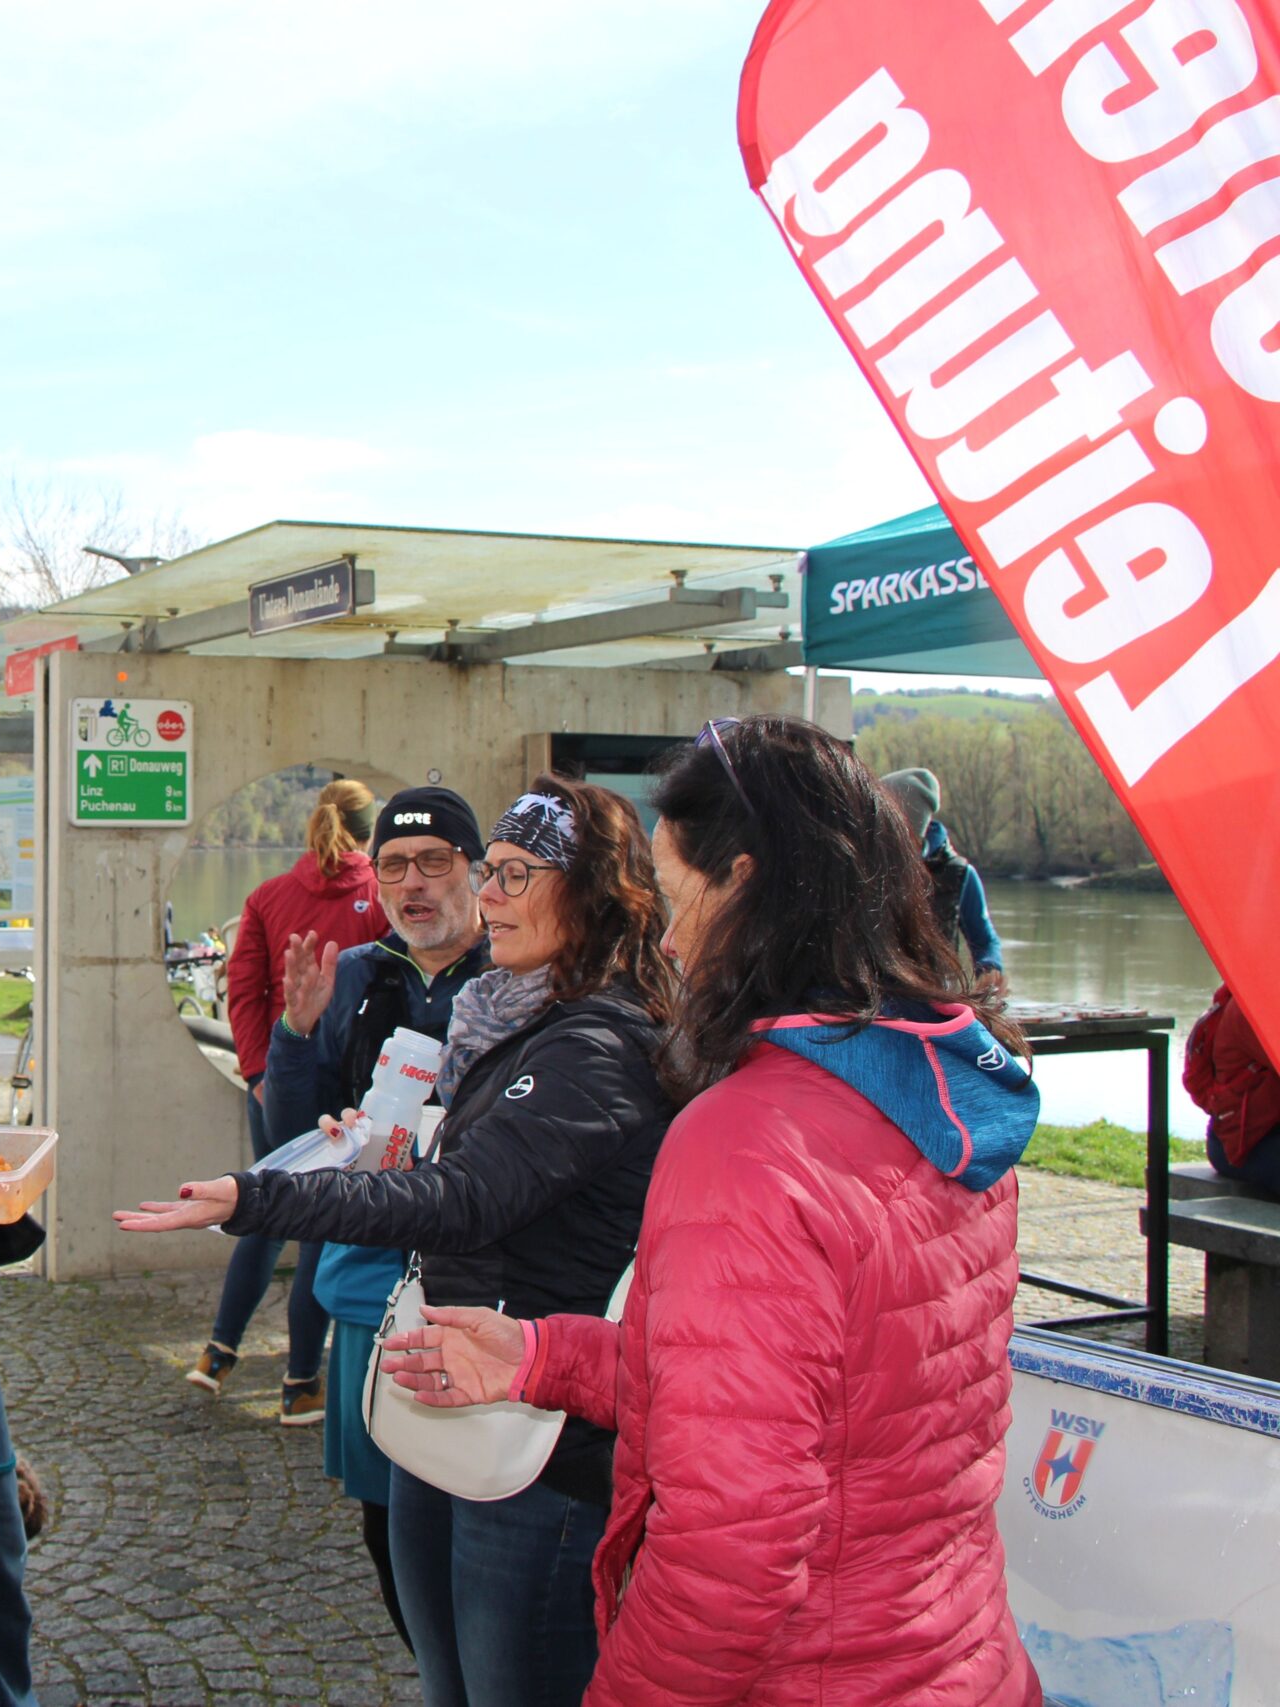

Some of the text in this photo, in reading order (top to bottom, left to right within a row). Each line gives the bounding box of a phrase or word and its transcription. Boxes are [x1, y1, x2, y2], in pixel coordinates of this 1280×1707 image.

[259, 574, 340, 621] Untere Donaulände
[111, 758, 183, 776] R1 Donauweg
[80, 785, 183, 797] Linz 9 km
[80, 800, 183, 812] Puchenau 6 km
[394, 812, 432, 826] GORE
[1050, 1408, 1106, 1438] WSV
[1023, 1476, 1087, 1520] OTTENSHEIM
